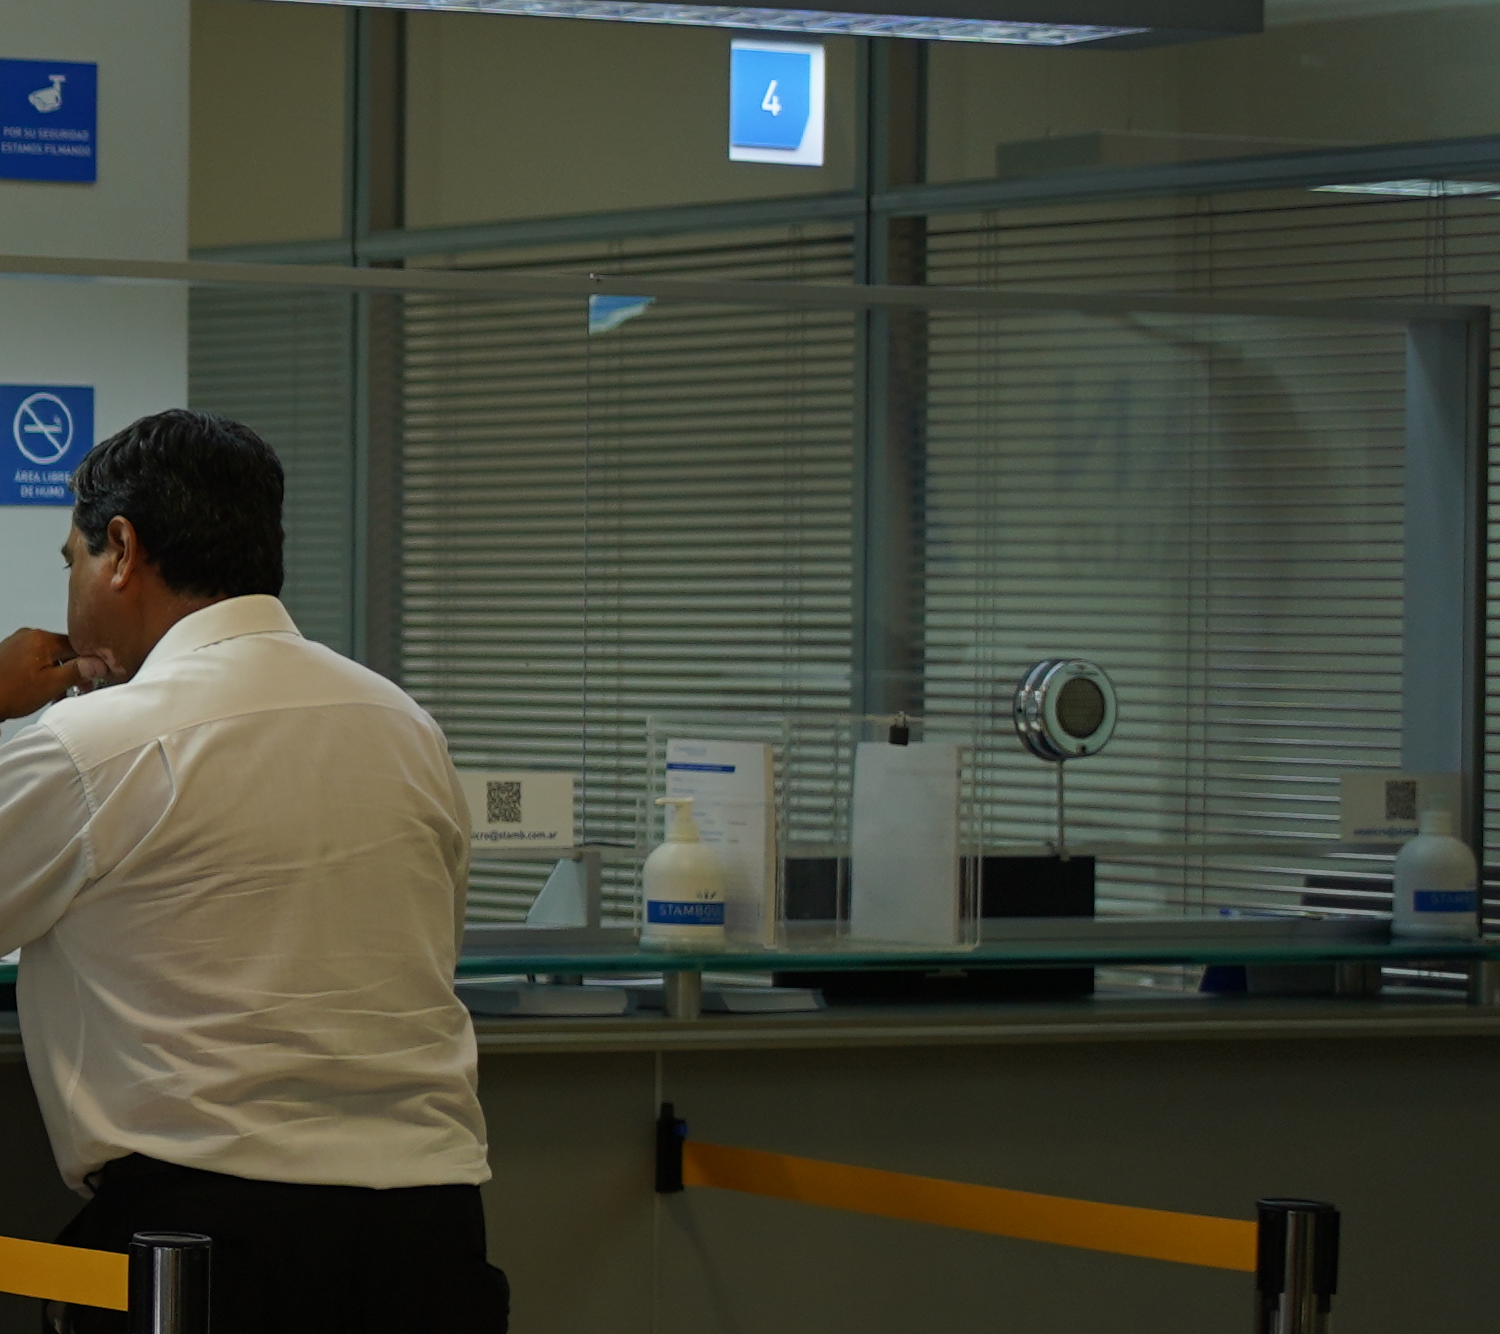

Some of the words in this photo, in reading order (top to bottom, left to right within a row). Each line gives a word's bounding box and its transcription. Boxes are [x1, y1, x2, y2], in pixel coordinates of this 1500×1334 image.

[761, 80, 782, 116] 4
[14, 468, 40, 483] ÁREA
[21, 485, 35, 498] DE
